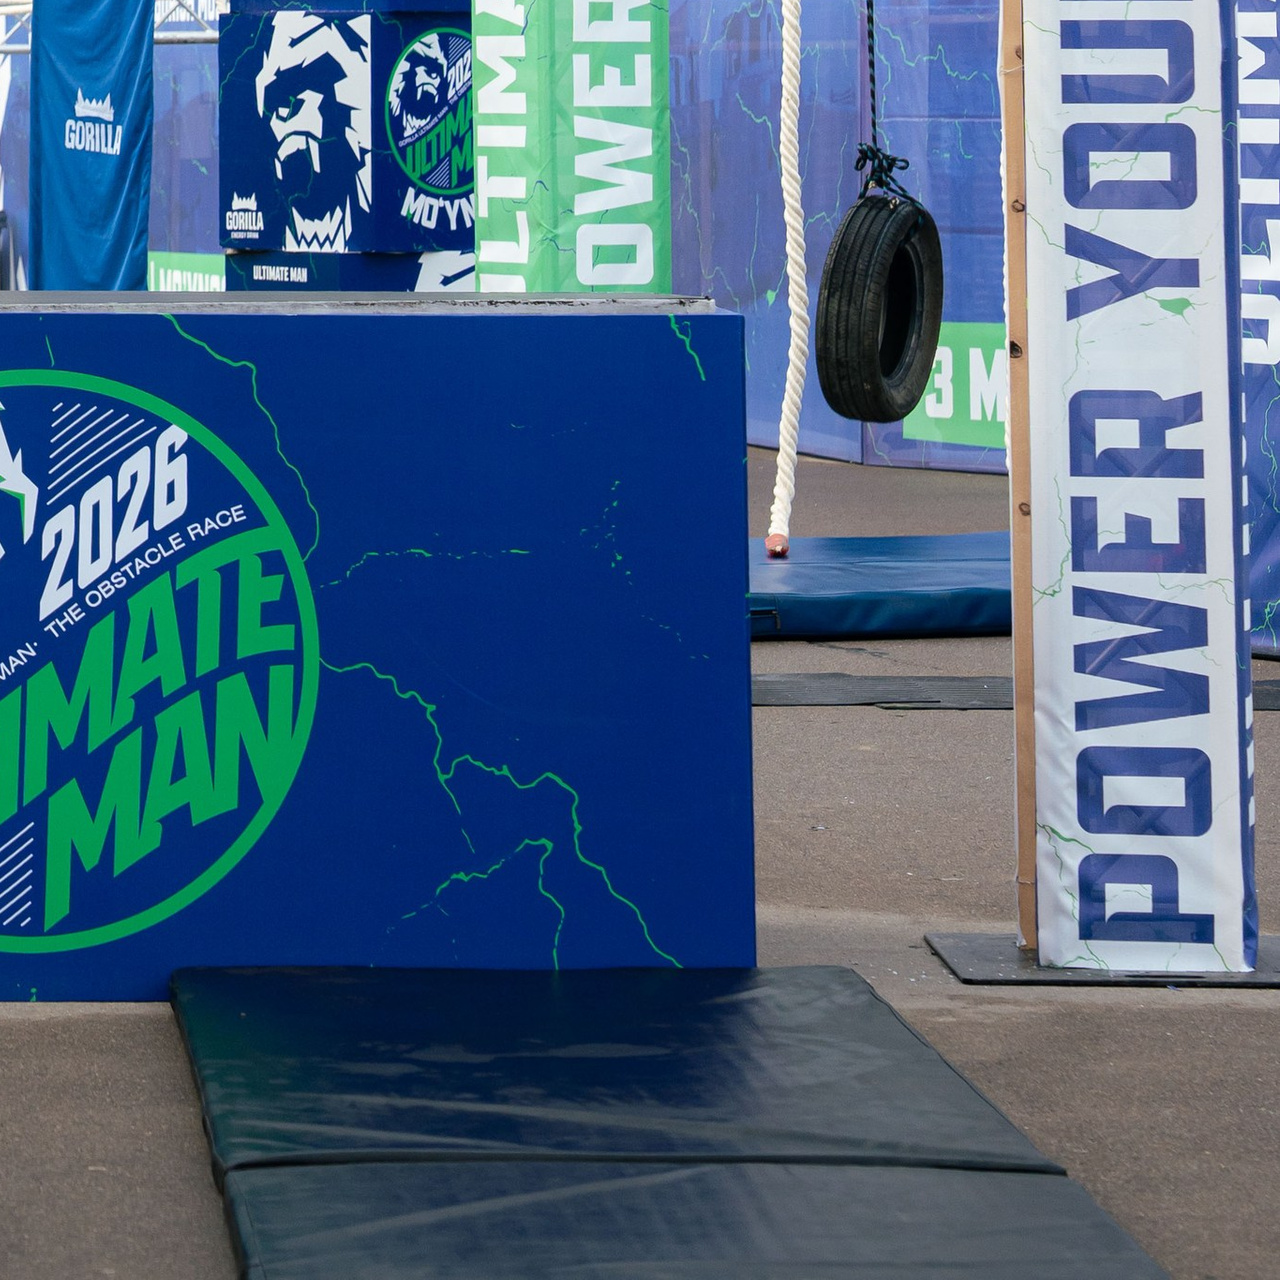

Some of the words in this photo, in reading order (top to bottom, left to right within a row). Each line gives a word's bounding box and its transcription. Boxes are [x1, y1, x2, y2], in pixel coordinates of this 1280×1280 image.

[65, 119, 122, 155] GORILLA
[226, 211, 264, 231] GORILLA
[253, 264, 289, 282] ULTIMATE
[290, 267, 308, 283] MAN
[925, 346, 954, 419] 3
[39, 423, 189, 621] 2026
[44, 604, 87, 640] THE
[84, 533, 184, 610] OBSTACLE
[185, 503, 247, 544] RACE
[1069, 390, 1215, 944] POWER
[44, 664, 296, 932] MAN
